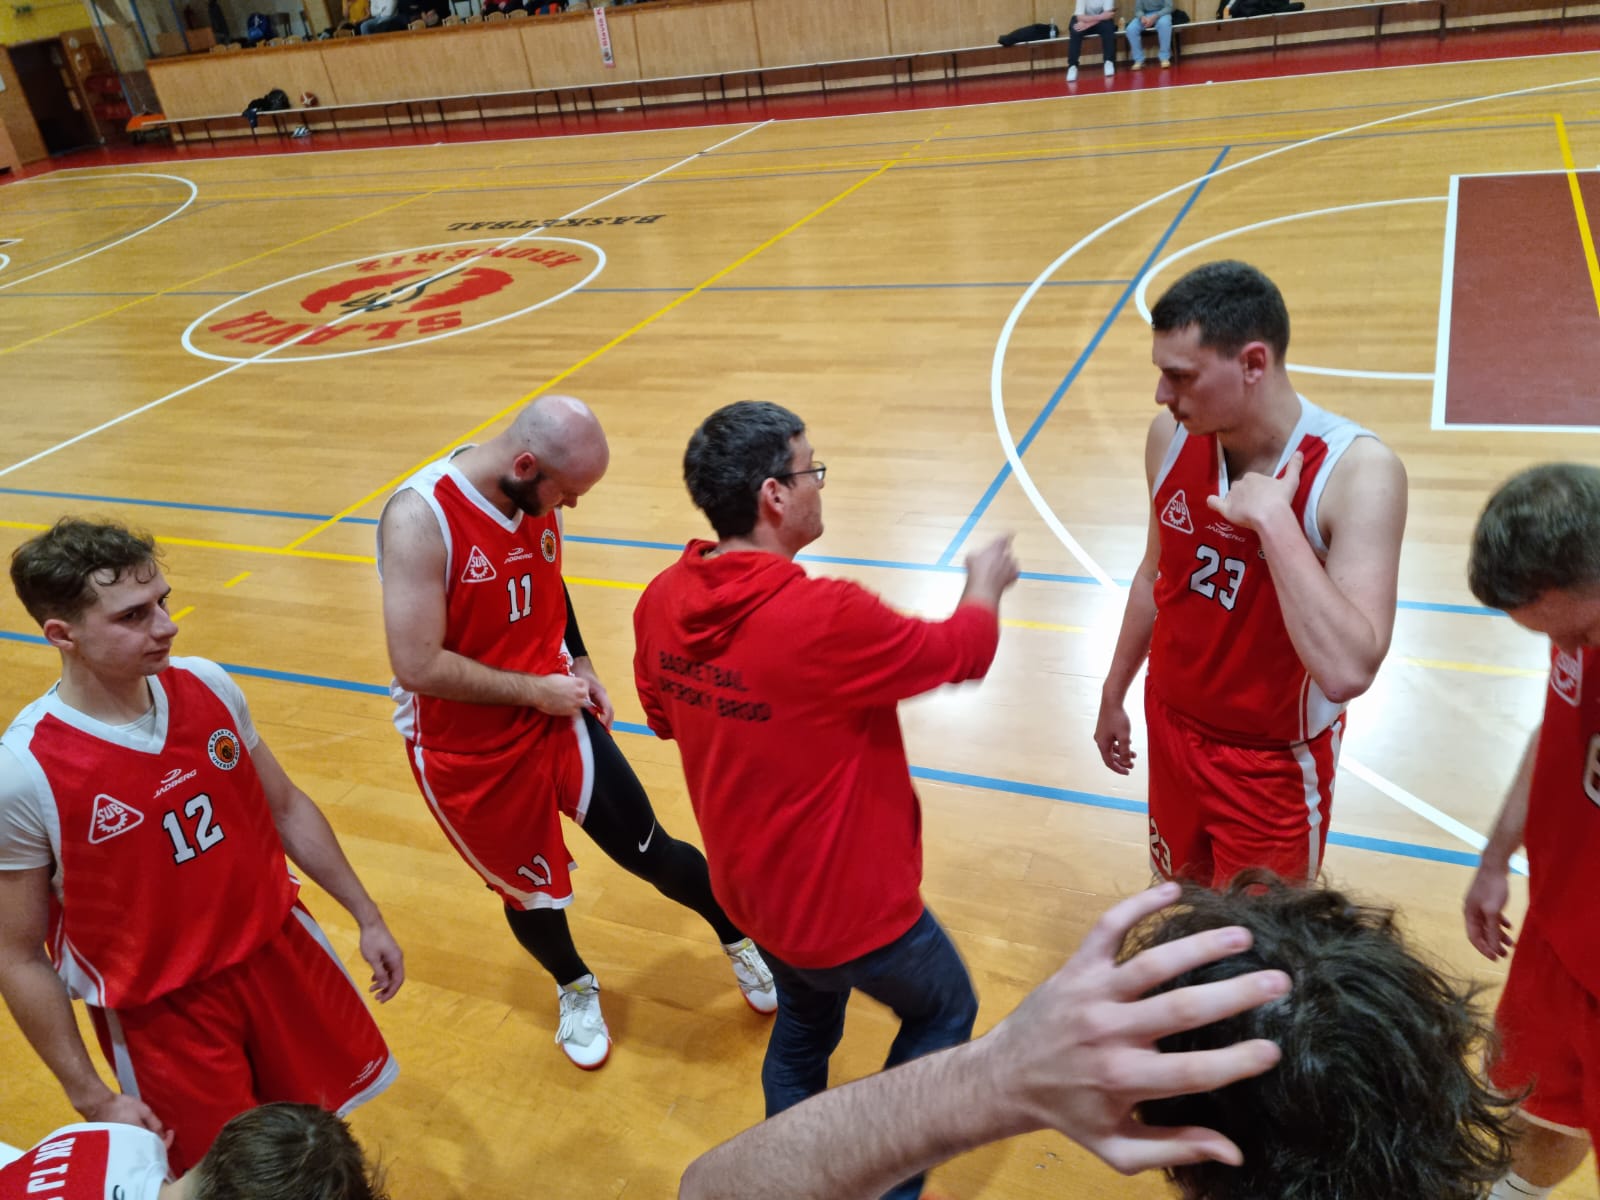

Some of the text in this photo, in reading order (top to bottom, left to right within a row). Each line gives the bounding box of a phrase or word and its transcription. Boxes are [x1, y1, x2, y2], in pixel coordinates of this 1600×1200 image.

[446, 214, 666, 232] BASKETBAL
[207, 310, 463, 346] SLAVIA
[1189, 543, 1247, 612] 23
[506, 572, 533, 624] 11
[152, 768, 198, 799] JADBERG
[96, 803, 126, 824] SUB
[161, 792, 225, 866] 12
[1149, 815, 1173, 877] 23
[26, 1162, 70, 1194] TJ
